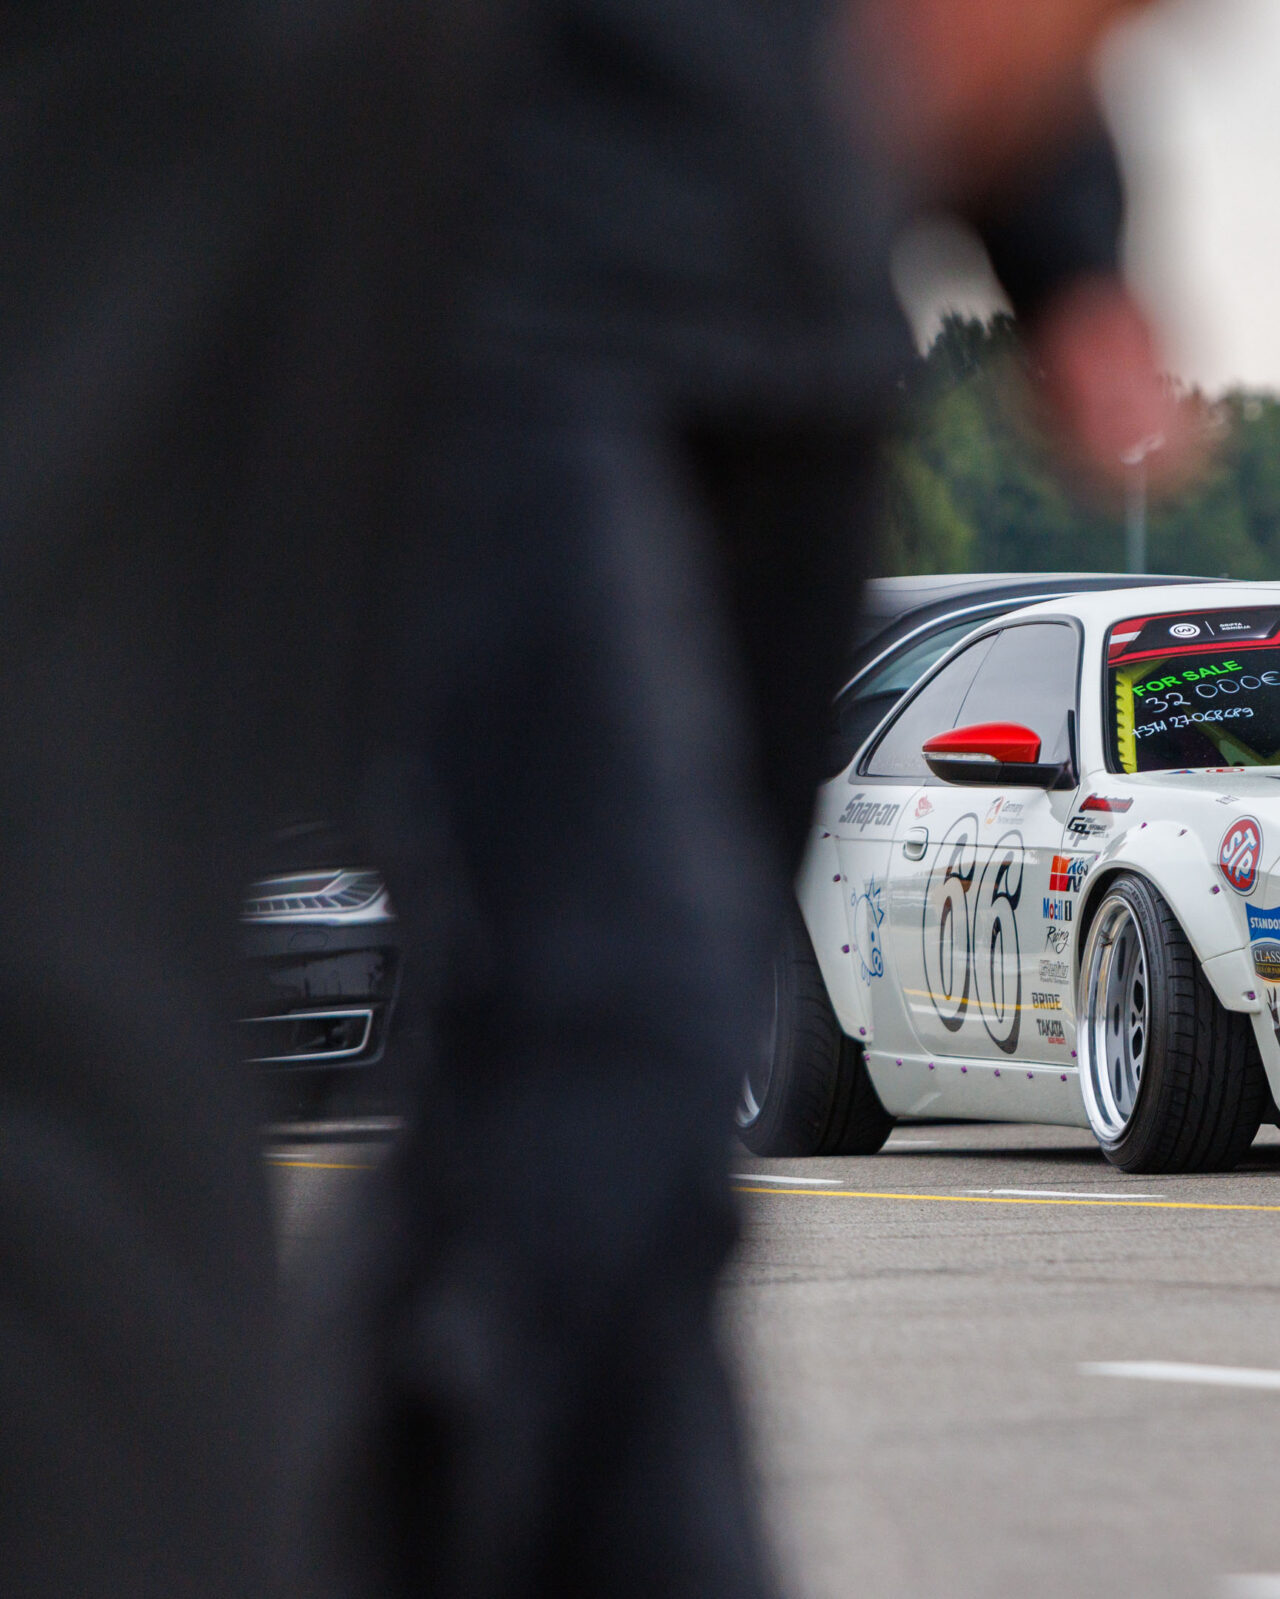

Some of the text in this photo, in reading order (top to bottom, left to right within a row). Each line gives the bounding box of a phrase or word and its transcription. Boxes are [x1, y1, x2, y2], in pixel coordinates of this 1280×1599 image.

[1132, 660, 1243, 697] FOR SALE
[1145, 692, 1191, 713] 32
[838, 793, 900, 833] Snap-on
[1222, 827, 1258, 883] STP
[1042, 897, 1073, 921] Mobil 1
[922, 812, 1024, 1055] 66
[1032, 992, 1063, 1011] BRIDE
[1036, 1018, 1066, 1038] TAKATA
